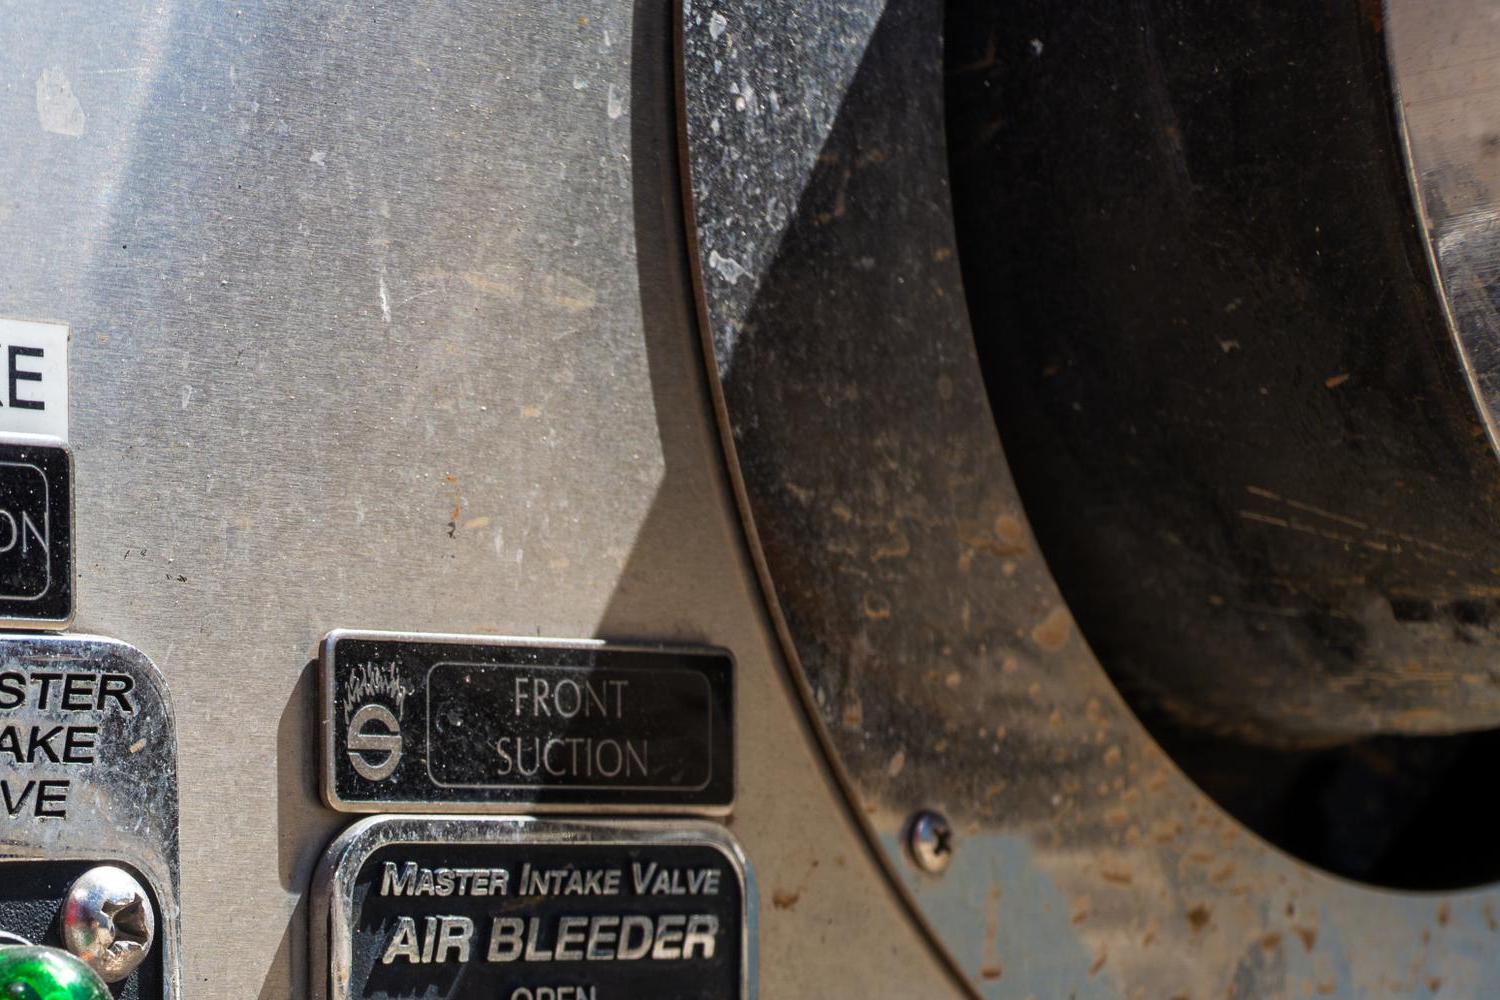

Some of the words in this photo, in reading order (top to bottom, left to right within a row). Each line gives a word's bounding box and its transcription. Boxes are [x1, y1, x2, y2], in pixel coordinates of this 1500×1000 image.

[514, 676, 630, 719] FRONT
[496, 737, 649, 778] SUCTION
[382, 915, 474, 965] AIR
[487, 914, 720, 963] BLEEDER
